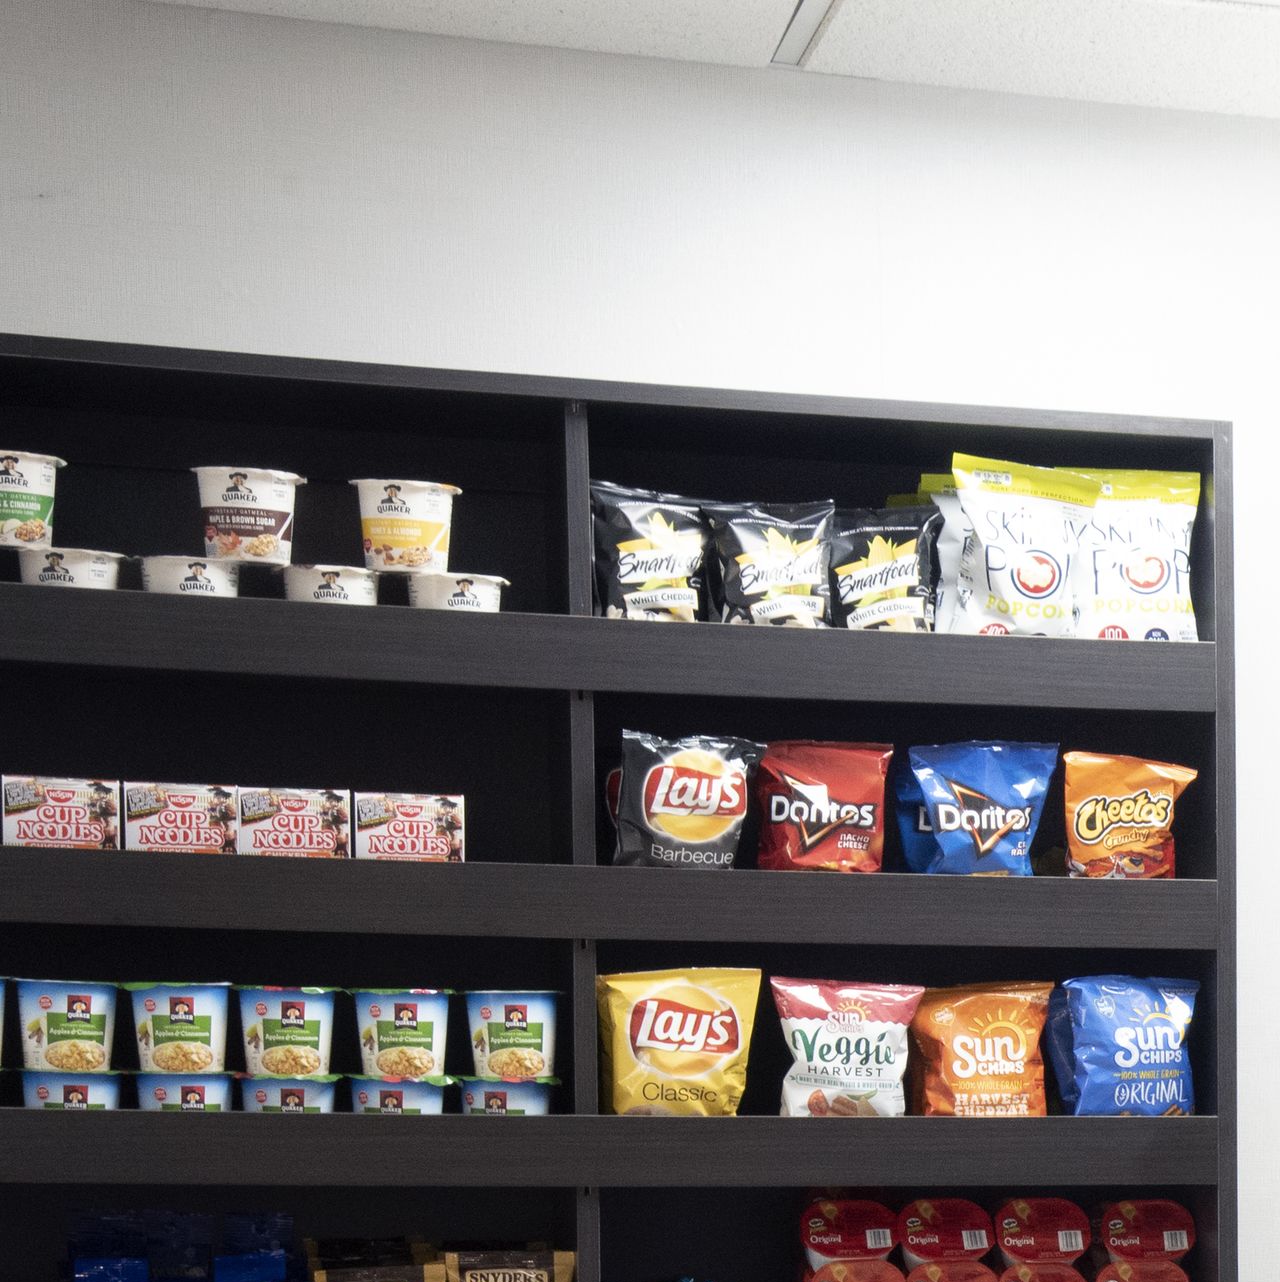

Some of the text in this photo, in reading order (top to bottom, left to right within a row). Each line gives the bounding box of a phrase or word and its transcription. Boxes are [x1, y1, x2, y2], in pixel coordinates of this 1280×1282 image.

[222, 493, 258, 503] QUAKER
[377, 505, 411, 514] QUAKER
[232, 515, 254, 525] BROWN
[256, 517, 276, 527] SUGAR
[38, 572, 75, 584] QUAKER
[839, 560, 918, 598] Smartfood
[179, 582, 216, 593] QUAKER
[313, 591, 349, 601] QUAKER
[447, 598, 482, 608] QUAKER
[38, 804, 86, 823] CUP
[771, 795, 875, 826] Doritos
[159, 810, 207, 828] CUP
[272, 814, 320, 832] CUP
[1076, 795, 1171, 843] Cheetos
[17, 821, 105, 843] NOODLES
[139, 826, 225, 847] NOODLES
[388, 820, 434, 838] CUP
[254, 830, 336, 850] NOODLES
[369, 835, 450, 856] NOODLES
[837, 840, 869, 850] CHEESE
[839, 834, 870, 843] NACHO
[1104, 830, 1149, 849] Crunchy
[651, 843, 734, 865] Barbecue
[636, 1001, 732, 1052] Lay's
[791, 1026, 896, 1065] Veggie
[1114, 1025, 1182, 1068] Sun
[953, 1035, 1026, 1078] Sun
[1140, 1050, 1182, 1064] CHIPS
[808, 1066, 883, 1077] HARVEST
[977, 1058, 1025, 1075] CHIPS
[1121, 1070, 1180, 1079] 100% WHOLE GRAIN
[642, 1082, 718, 1103] Classic
[958, 1080, 1023, 1090] 100% WHOLE GRAIN
[954, 1094, 1030, 1106] HARVEST
[954, 1105, 1029, 1115] CHEDDAR
[809, 1235, 842, 1246] Original
[908, 1235, 939, 1246] Original
[1004, 1236, 1035, 1247] Original
[1110, 1237, 1140, 1248] Original
